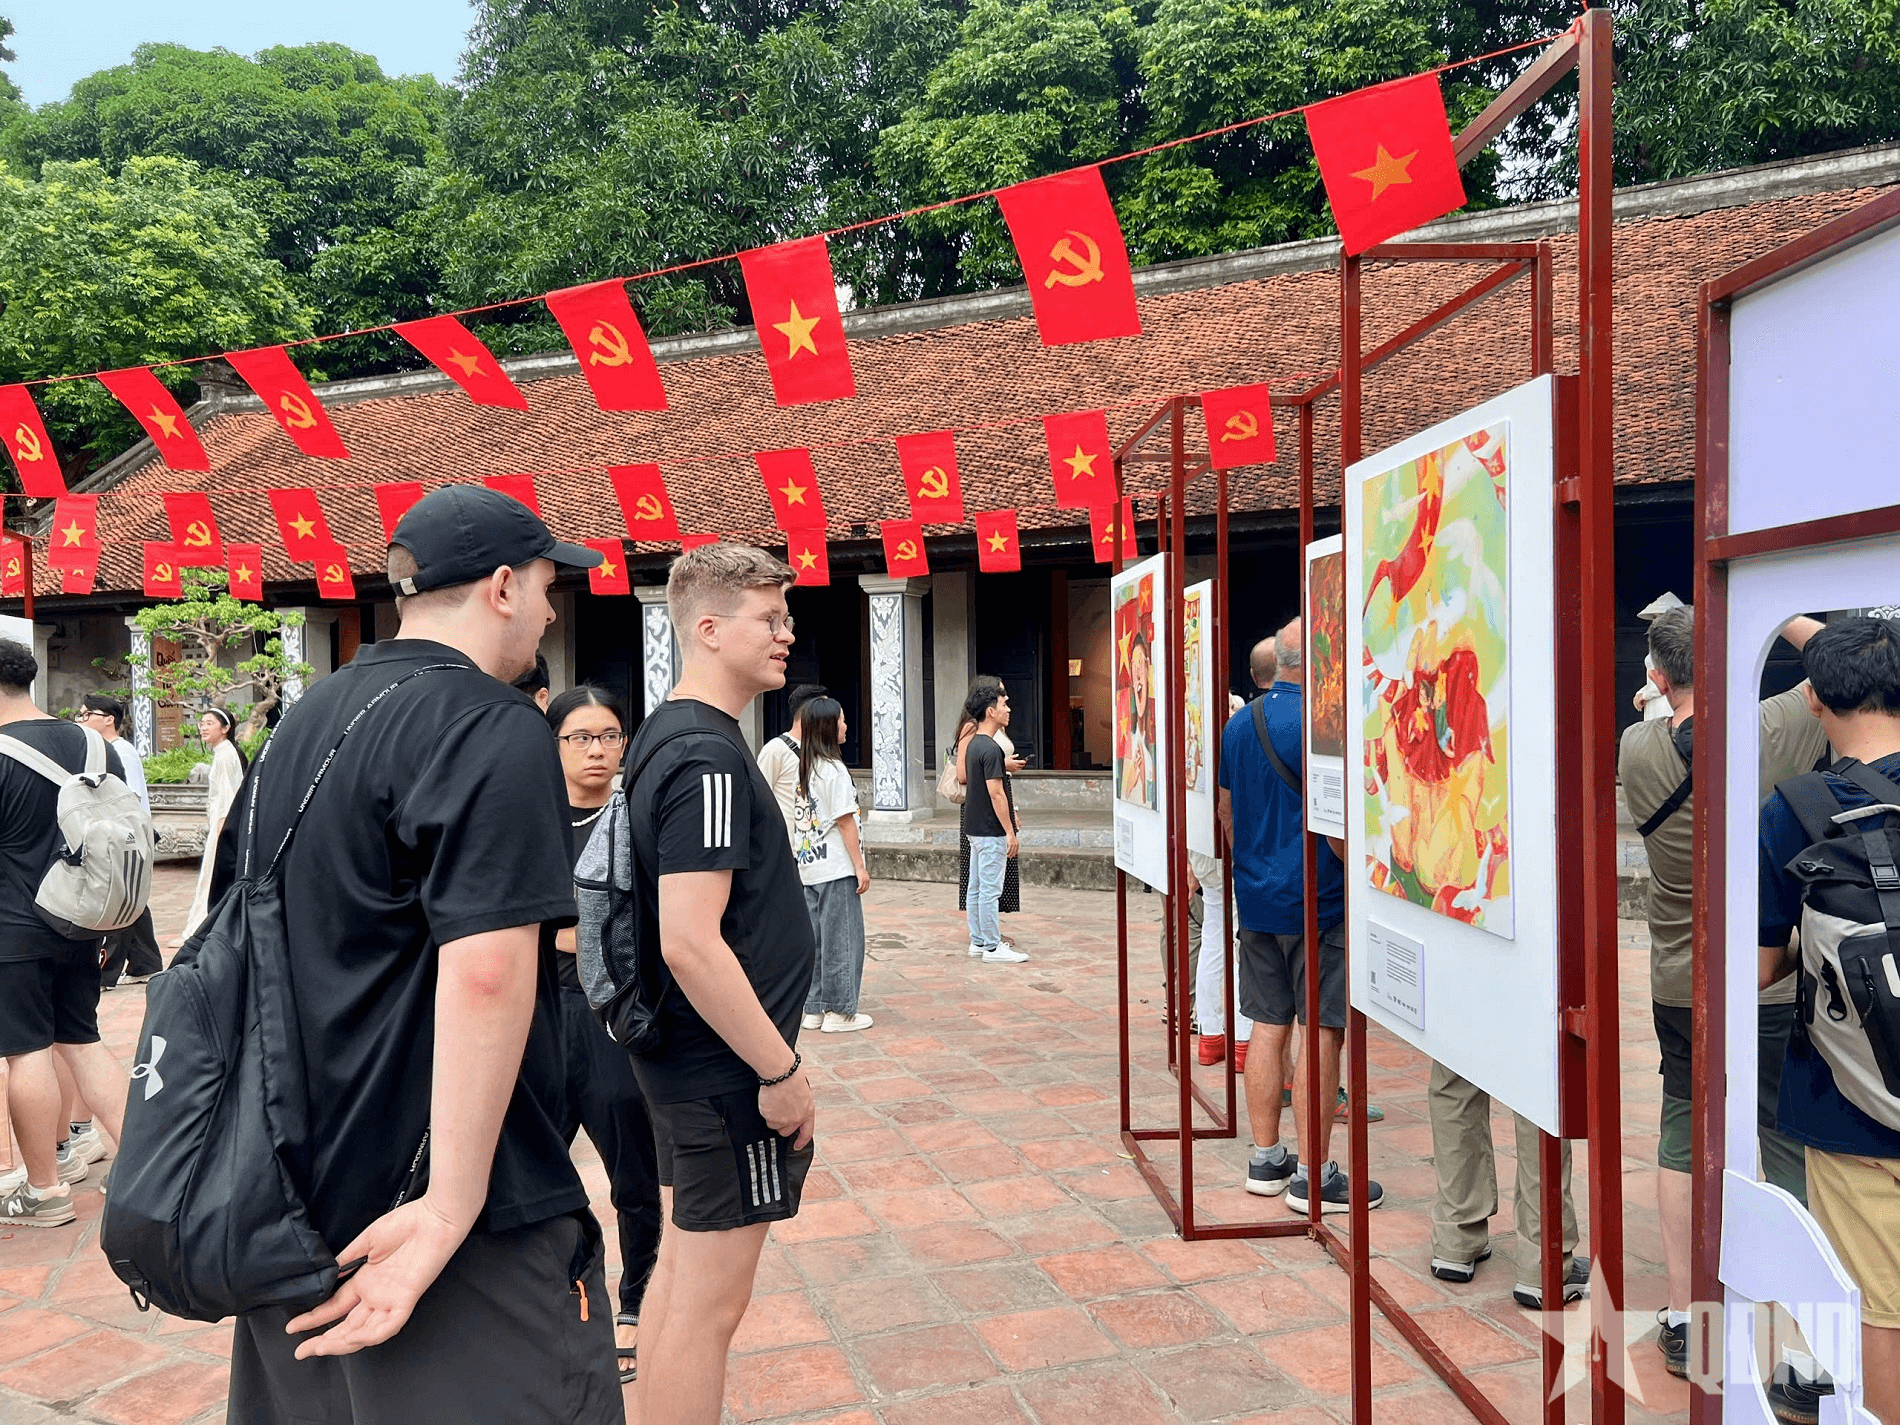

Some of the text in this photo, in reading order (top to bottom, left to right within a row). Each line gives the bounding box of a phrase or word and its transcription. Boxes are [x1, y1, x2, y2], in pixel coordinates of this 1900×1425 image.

[366, 682, 399, 709] ARMOUR
[298, 748, 337, 813] UNDER ARMOUR
[8, 1199, 23, 1216] N
